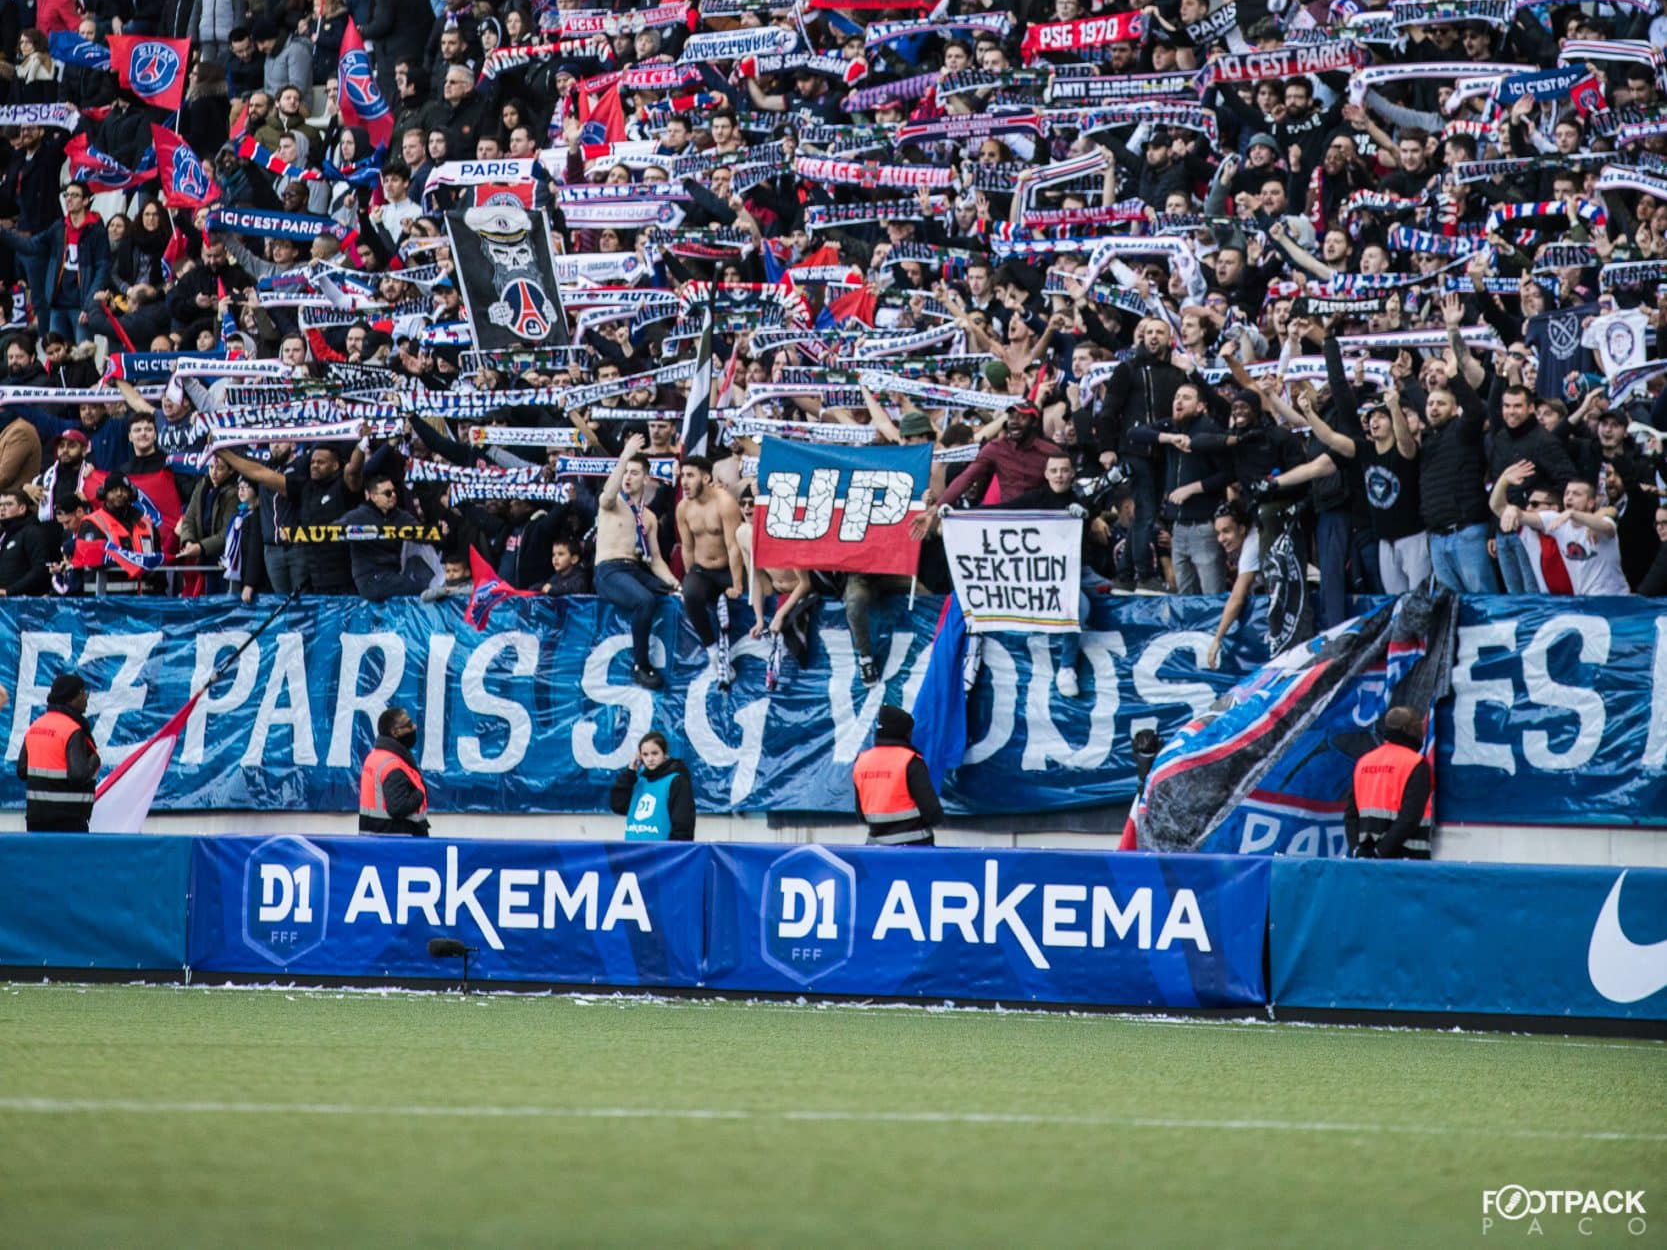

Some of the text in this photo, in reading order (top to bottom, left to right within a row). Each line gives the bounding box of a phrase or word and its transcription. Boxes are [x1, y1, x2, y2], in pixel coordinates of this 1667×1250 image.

[1040, 18, 1118, 47] PSG 1970
[1186, 2, 1237, 42] PARIS
[1218, 55, 1242, 79] ICI
[1053, 81, 1086, 98] ANTI
[1509, 82, 1525, 95] ICI
[1527, 79, 1556, 93] C'EST
[461, 162, 519, 177] PARIS
[976, 169, 1013, 190] RAS
[220, 211, 323, 234] ICI C'EST PARIS
[134, 358, 173, 371] ICI C'ES
[765, 467, 915, 543] UP
[982, 527, 1043, 556] LCC
[956, 554, 1067, 583] SEKTION
[966, 584, 1062, 614] CHICHA
[180, 630, 541, 774] PARIS
[571, 632, 788, 806] SG
[1451, 613, 1613, 776] ES
[258, 845, 652, 951] D1 ARKEMA
[778, 858, 1212, 970] D1 ARKEMA
[270, 931, 298, 944] FFF
[791, 948, 823, 961] FFF
